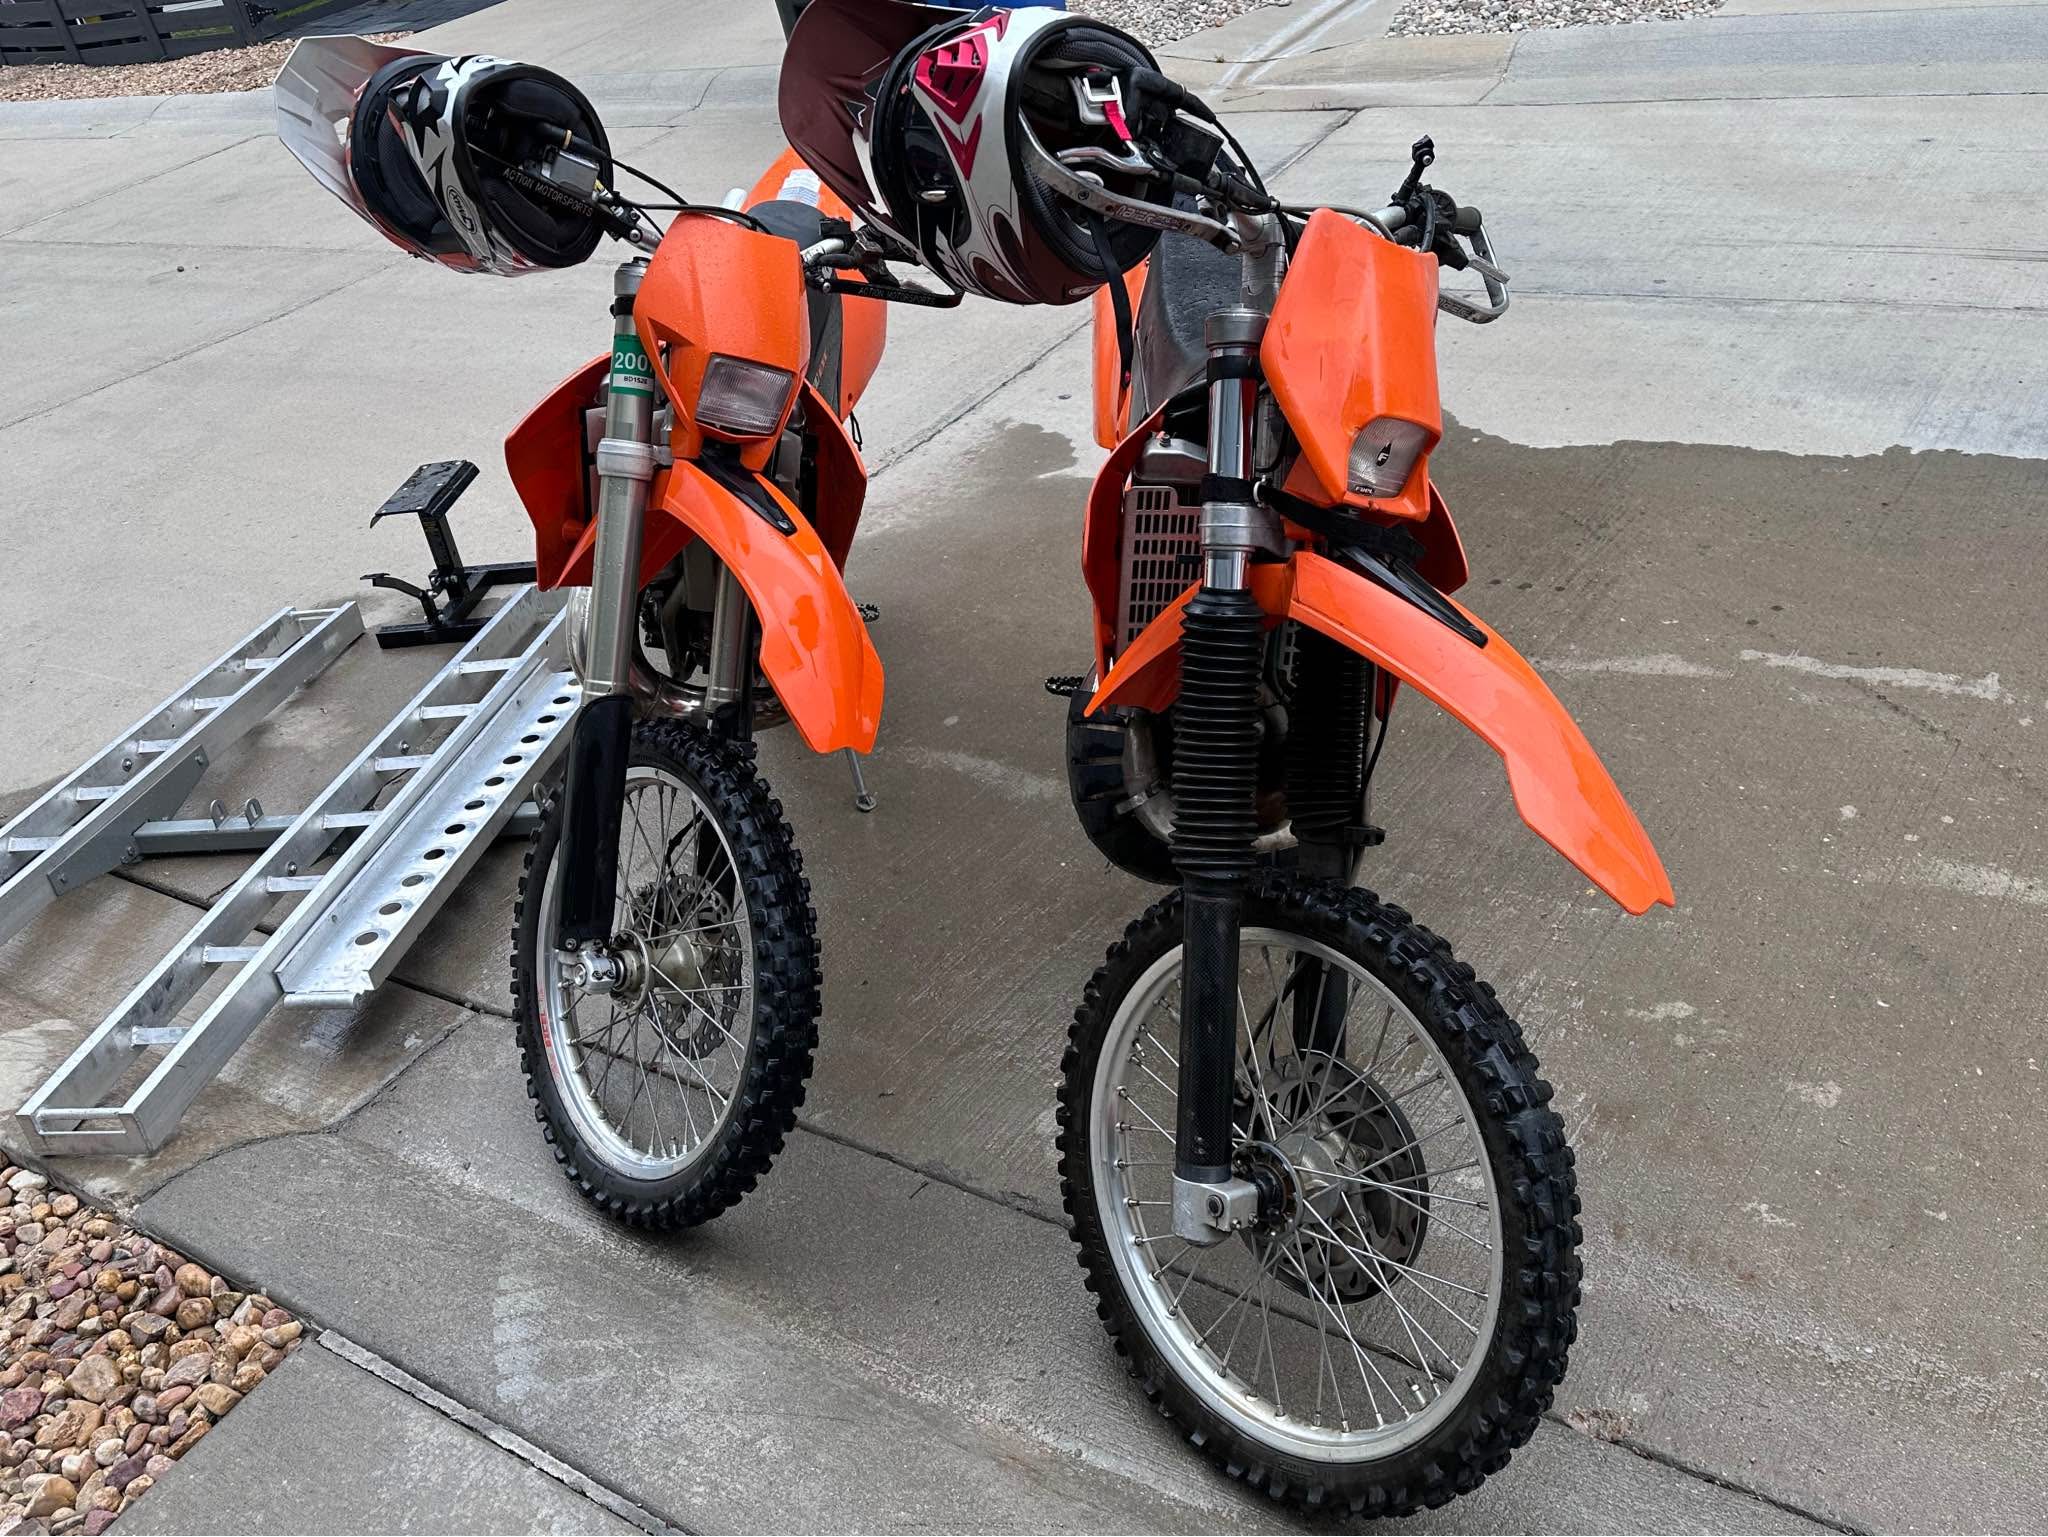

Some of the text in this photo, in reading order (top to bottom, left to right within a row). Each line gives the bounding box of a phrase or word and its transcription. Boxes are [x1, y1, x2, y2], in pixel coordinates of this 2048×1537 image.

[502, 167, 593, 217] ACTION MOTORSPORTS
[858, 286, 936, 306] ACTION MOTORSPORTS
[614, 351, 653, 373] 200
